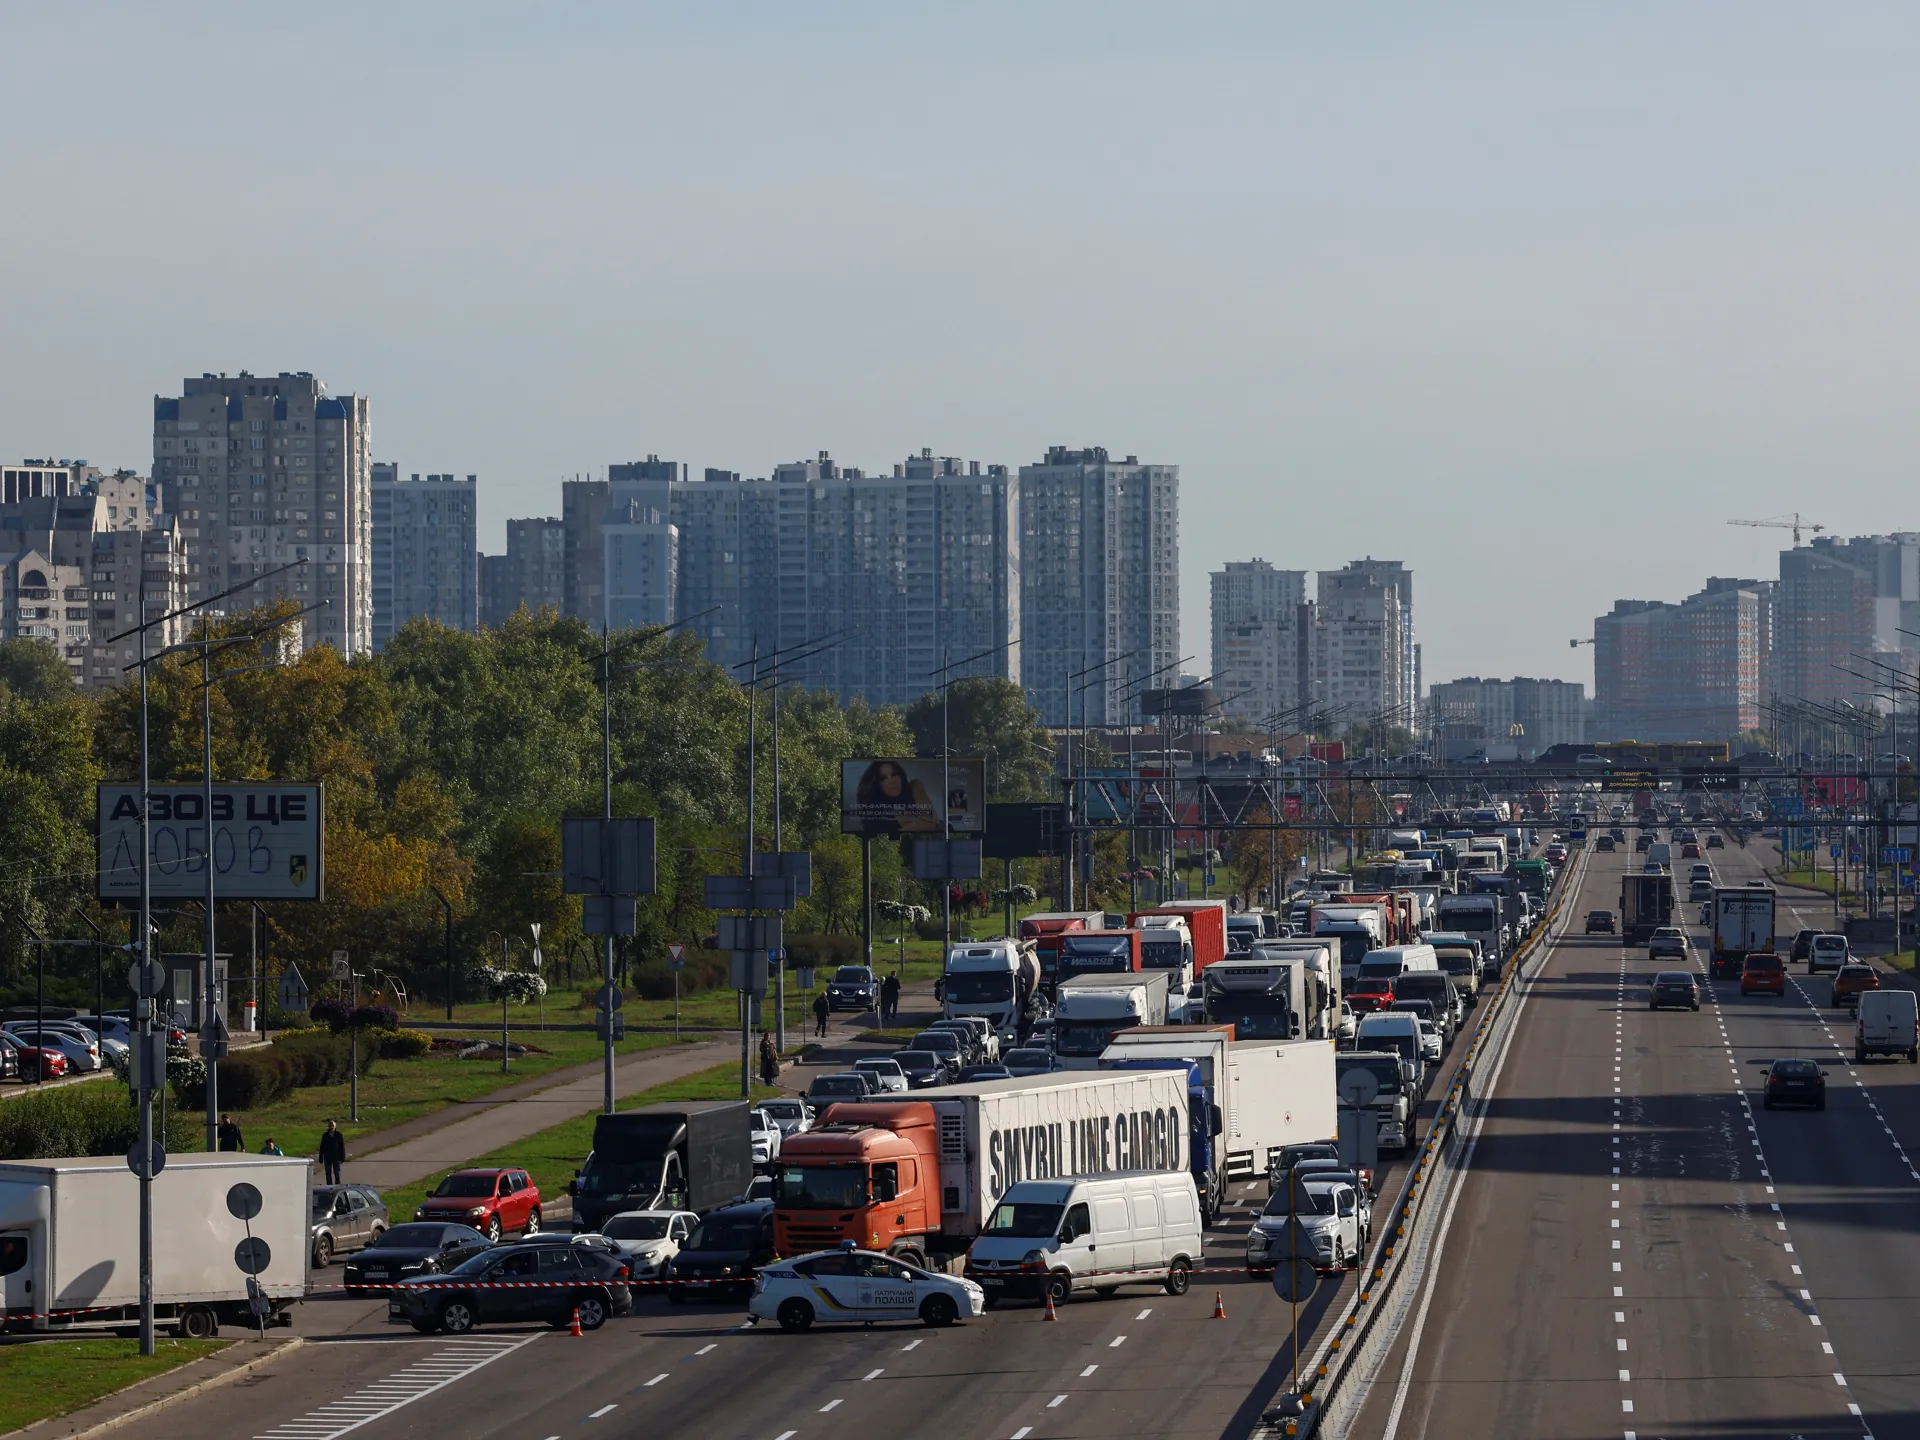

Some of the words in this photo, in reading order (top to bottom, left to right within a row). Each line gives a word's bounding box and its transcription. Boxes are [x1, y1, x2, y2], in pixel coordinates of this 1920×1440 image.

[109, 794, 234, 821] АЗОВ
[246, 794, 307, 825] ЦЕ
[989, 1122, 1063, 1200] SMYRIL
[1070, 1116, 1111, 1176] LINE
[1115, 1106, 1180, 1171] CARGO
[874, 1296, 914, 1305] ПОЛІЦІЯ
